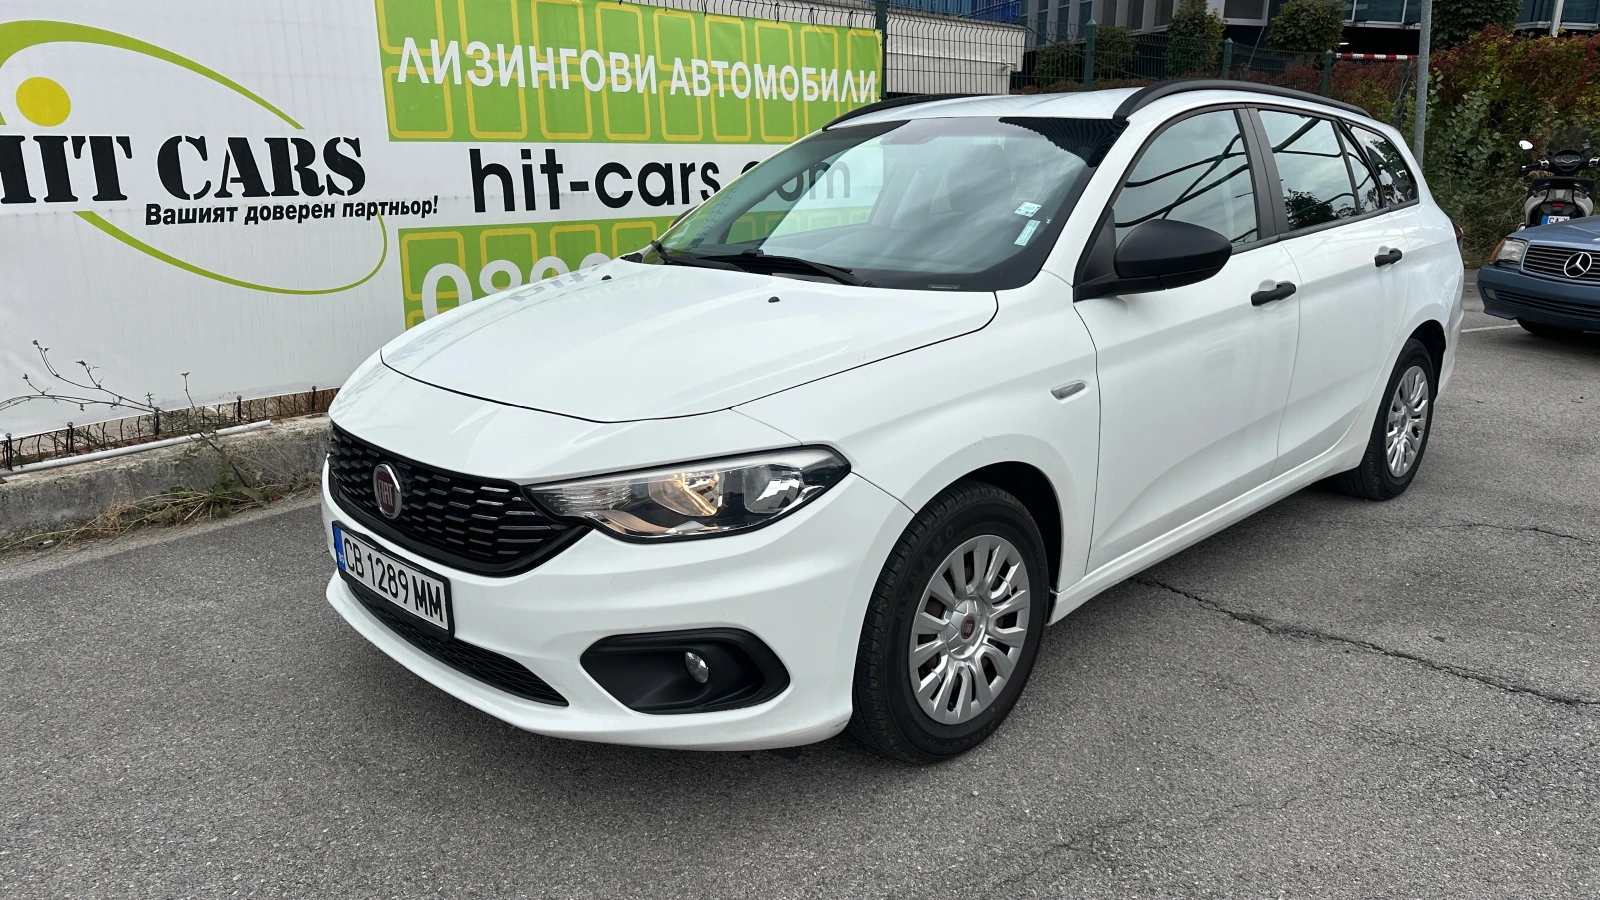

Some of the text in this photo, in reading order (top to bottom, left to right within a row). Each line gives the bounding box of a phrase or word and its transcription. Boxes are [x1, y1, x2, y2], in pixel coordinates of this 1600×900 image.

[397, 37, 876, 103] ЛИЗИНГОВИ АВТОМОБИЛИ
[157, 135, 366, 200] CARS
[145, 196, 439, 226] Вашият доверен партньор!
[378, 479, 394, 507] FIAT
[343, 538, 444, 622] CB 1289 MM
